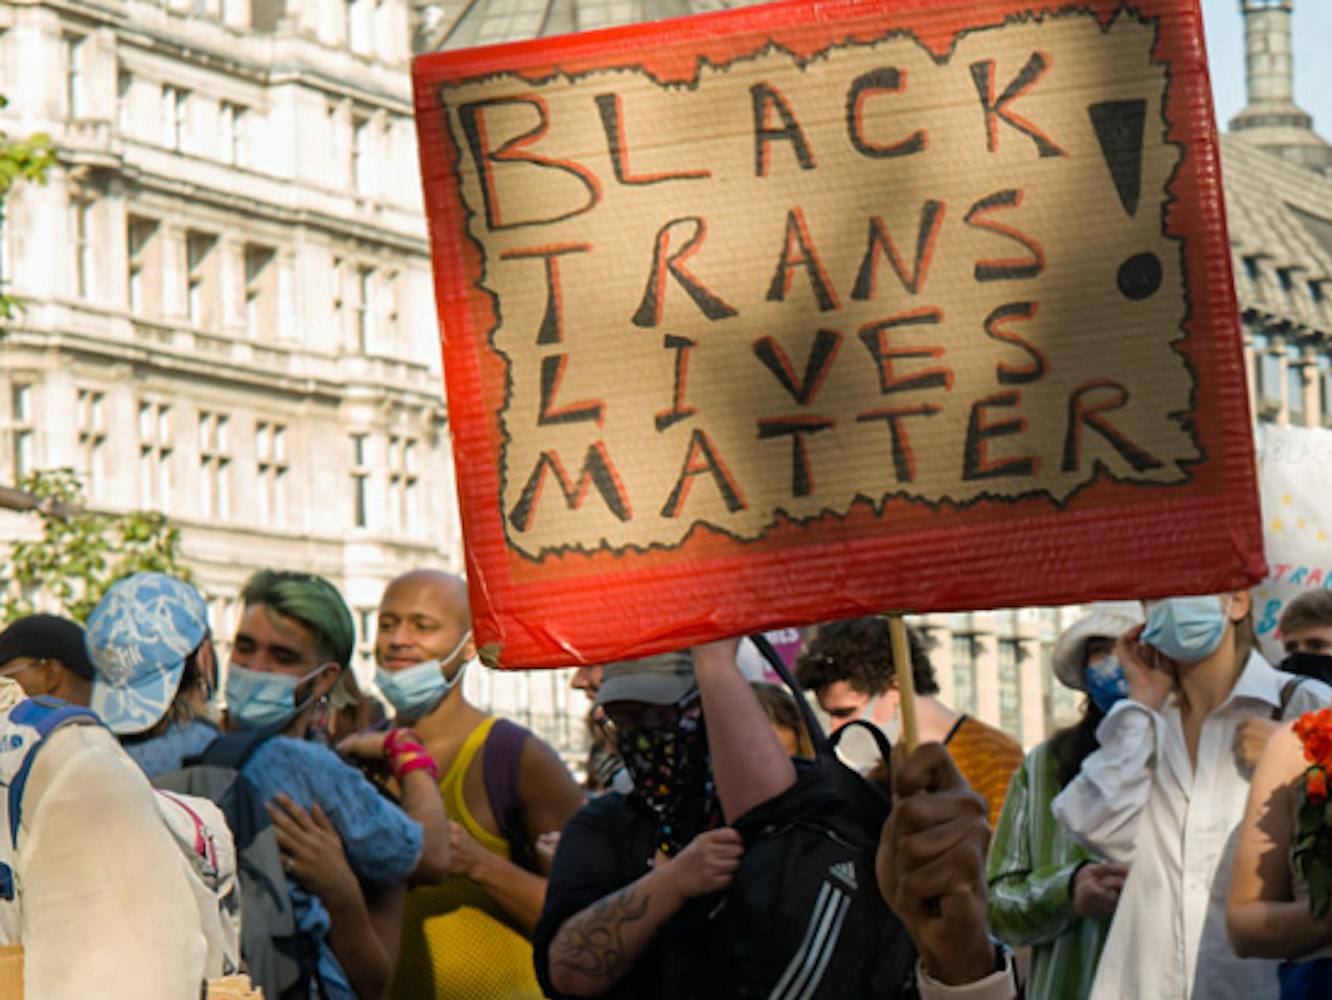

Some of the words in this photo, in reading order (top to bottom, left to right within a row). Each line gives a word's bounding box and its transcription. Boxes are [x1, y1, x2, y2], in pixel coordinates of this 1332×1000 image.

[457, 51, 1069, 232] BLACK
[499, 188, 1046, 346] TRANS
[536, 301, 1049, 431] LIVES
[510, 379, 1164, 533] MATTER
